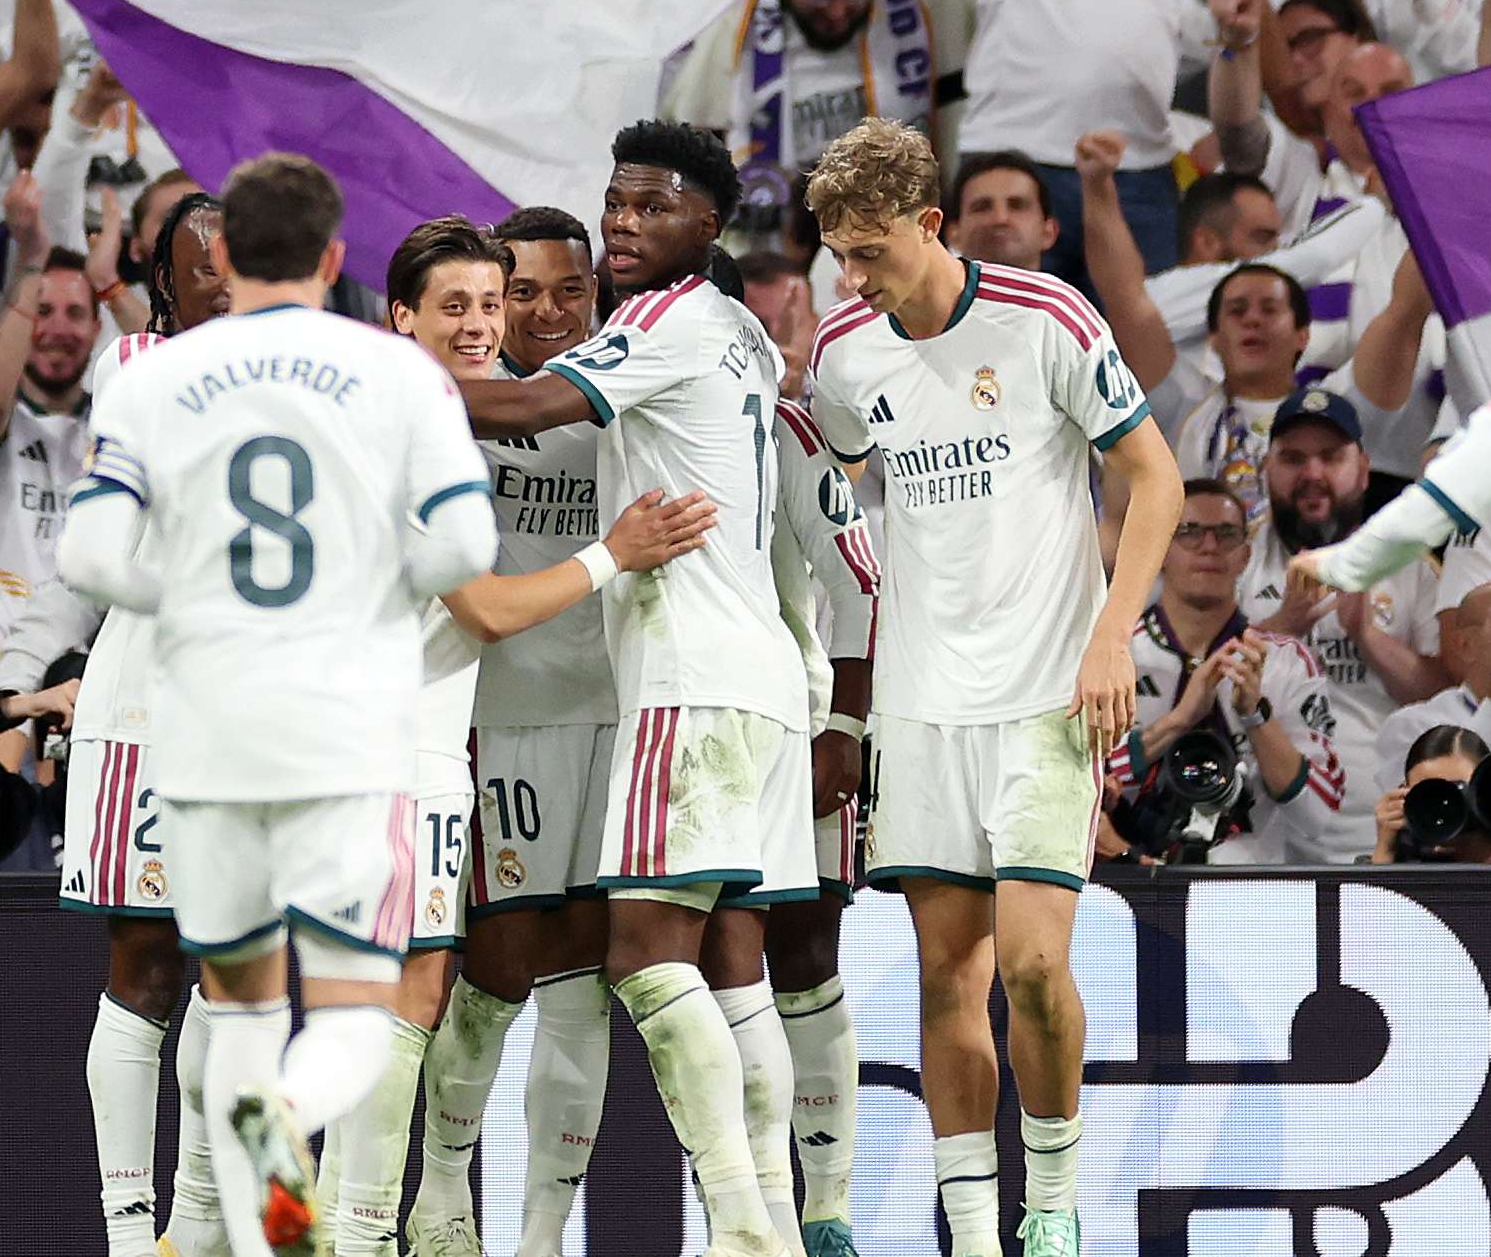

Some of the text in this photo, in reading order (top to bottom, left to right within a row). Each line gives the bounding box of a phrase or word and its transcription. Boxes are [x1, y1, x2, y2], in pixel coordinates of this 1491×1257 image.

[175, 354, 363, 416] VALVERDE
[880, 433, 1011, 478] Emirates
[495, 463, 597, 505] Emira
[928, 470, 993, 505] BETTER
[227, 434, 315, 609] 8
[515, 506, 600, 536] FLY BETTE
[486, 777, 542, 842] 10
[426, 812, 463, 879] 15
[794, 1093, 839, 1108] MCF
